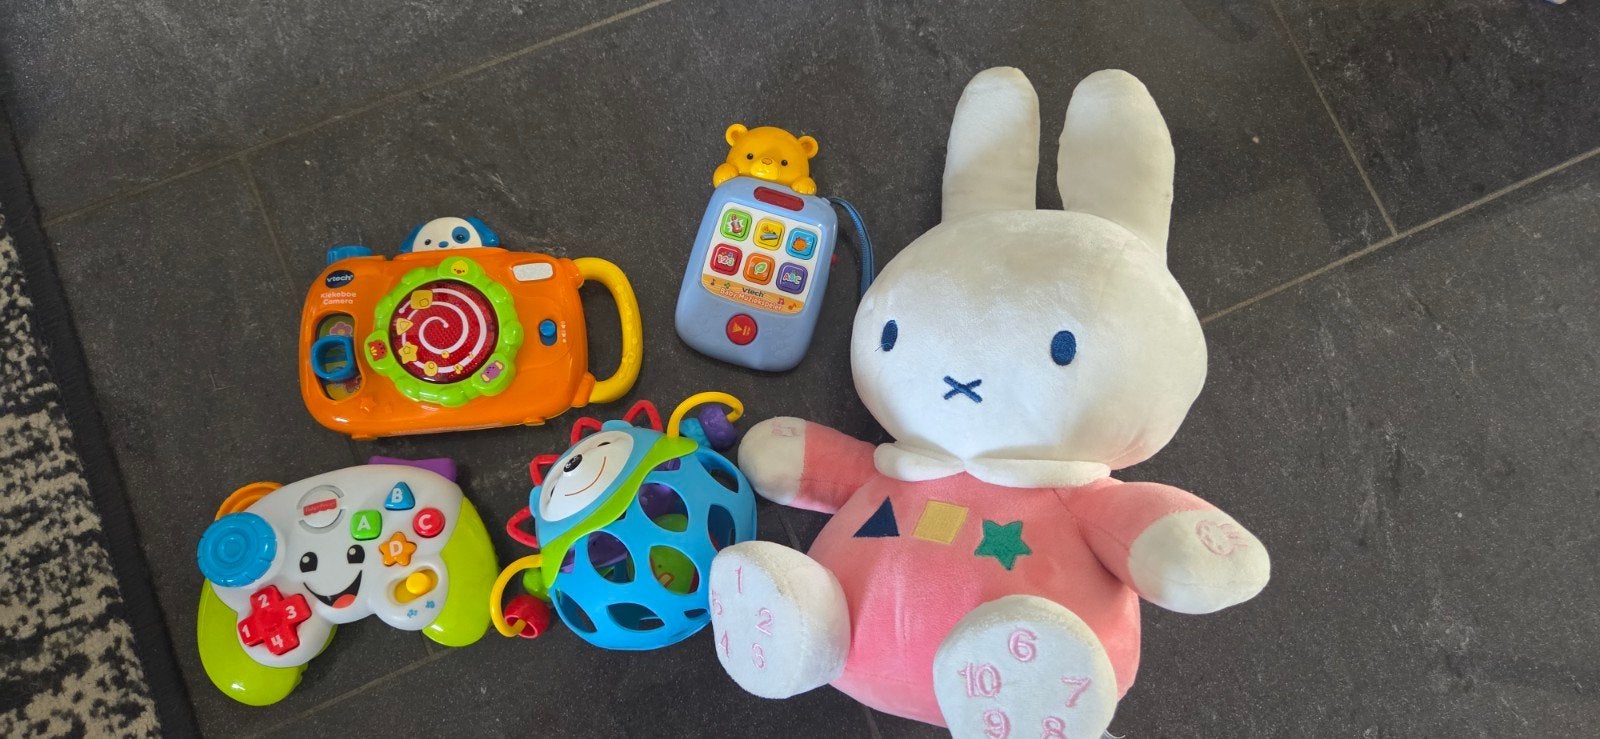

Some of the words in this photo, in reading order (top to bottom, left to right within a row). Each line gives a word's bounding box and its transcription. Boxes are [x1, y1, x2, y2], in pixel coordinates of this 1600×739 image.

[717, 255, 734, 266] 123
[783, 272, 801, 284] ABC
[392, 489, 402, 502] B
[357, 516, 371, 529] A
[419, 515, 432, 530] C
[390, 541, 402, 555] D
[735, 565, 742, 594] 1
[258, 595, 270, 608] 2
[711, 590, 723, 616] 5
[286, 606, 297, 619] 3
[755, 607, 772, 636] 2
[241, 627, 251, 638] 1
[271, 636, 283, 648] 4
[718, 630, 730, 659] 4
[1008, 629, 1038, 662] 6
[957, 662, 1001, 698] 10
[1060, 677, 1092, 708] 7
[983, 709, 1010, 739] 9
[1040, 716, 1067, 739] 8
